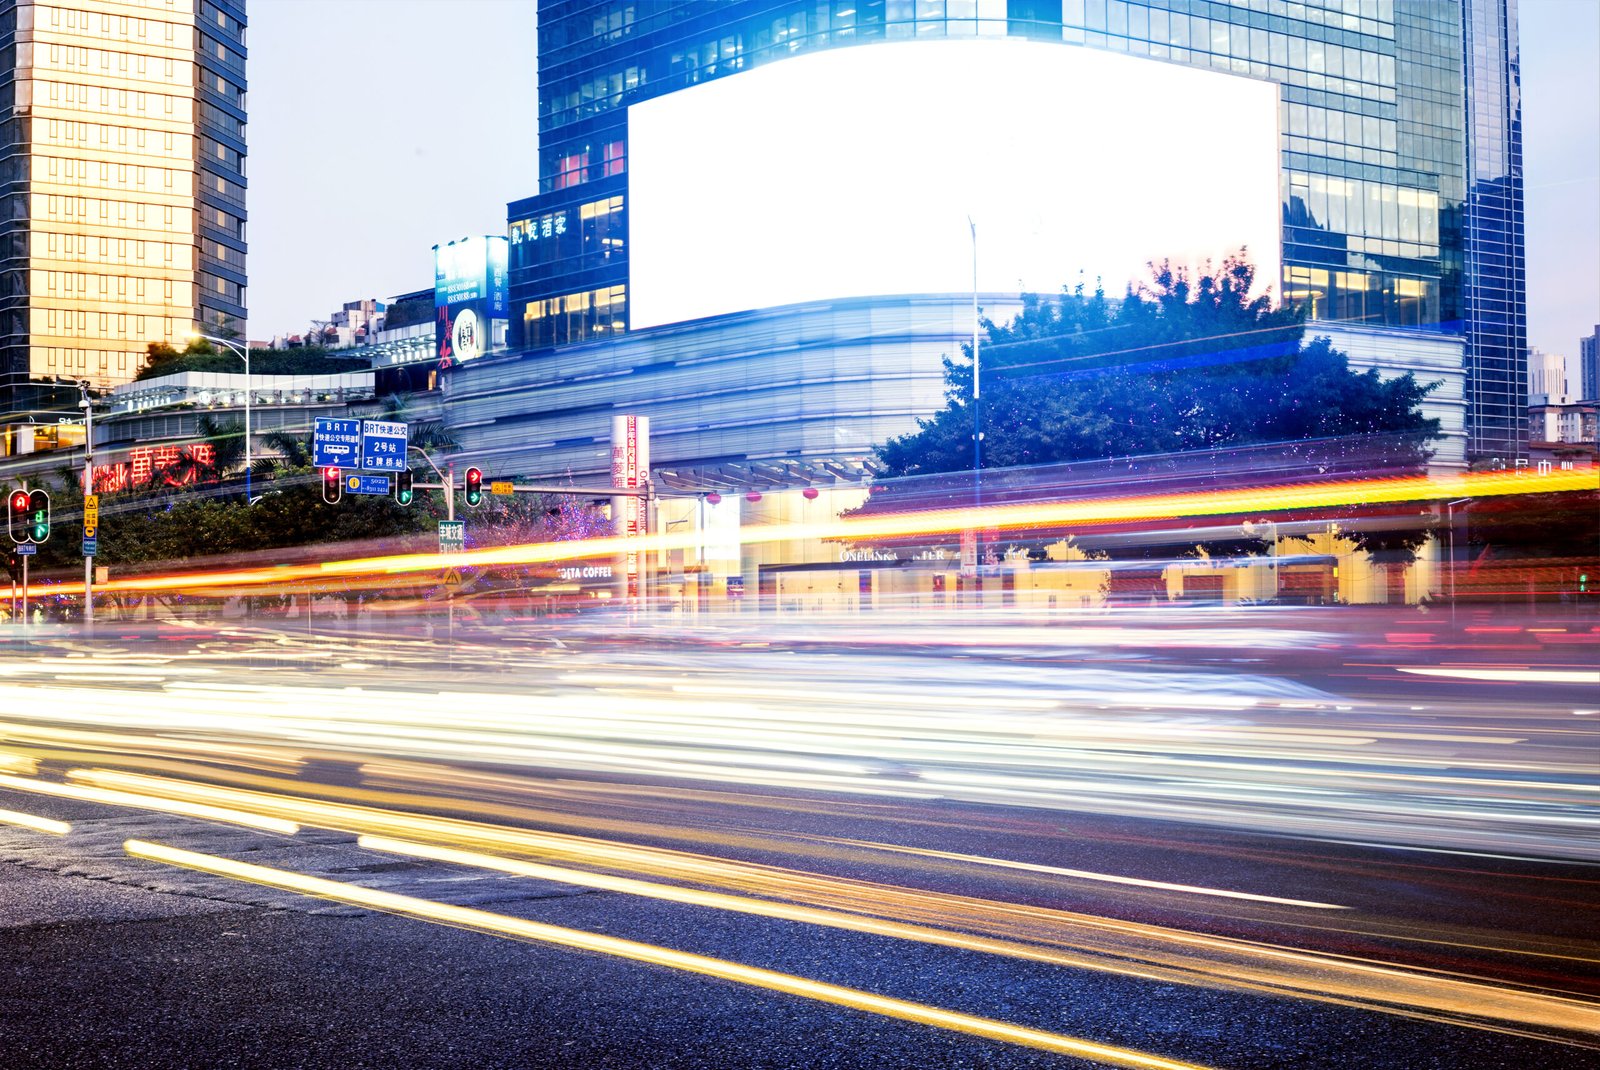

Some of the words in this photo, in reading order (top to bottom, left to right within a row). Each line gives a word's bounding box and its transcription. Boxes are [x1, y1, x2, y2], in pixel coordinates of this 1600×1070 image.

[326, 422, 348, 431] BRT
[364, 423, 407, 436] BRT快速公交
[373, 441, 397, 453] 2号站
[366, 456, 403, 468] 石牌桥站
[583, 566, 611, 578] COFFEE
